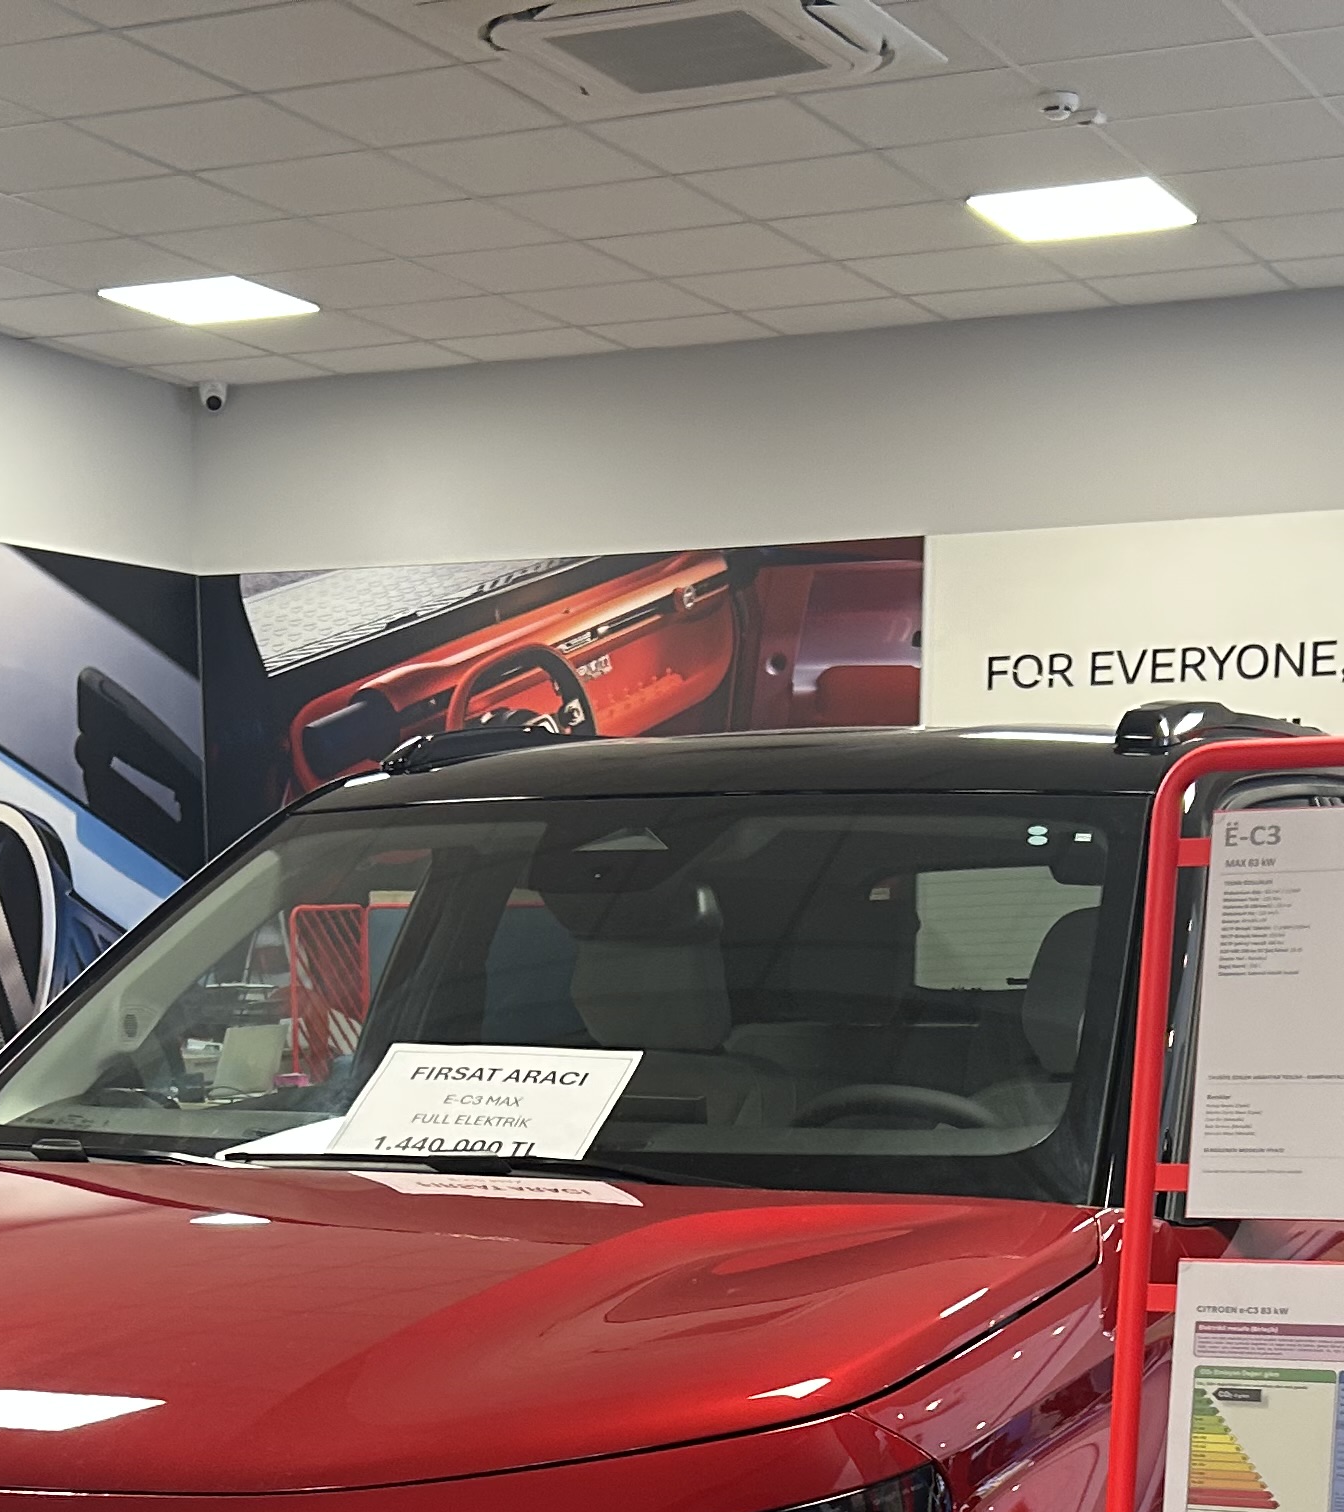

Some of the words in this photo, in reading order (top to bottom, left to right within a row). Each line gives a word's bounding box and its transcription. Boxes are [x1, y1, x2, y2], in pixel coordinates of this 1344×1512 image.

[987, 652, 1074, 690] FOR
[1225, 822, 1281, 846] Ë-C3
[410, 1066, 503, 1083] FIRSAT
[501, 1069, 589, 1086] ARACI
[443, 1094, 482, 1106] E-C3
[485, 1096, 523, 1107] MAX
[411, 1113, 452, 1125] FULL
[454, 1114, 532, 1128] ELEKTRİK
[374, 1135, 504, 1153] 1.440000
